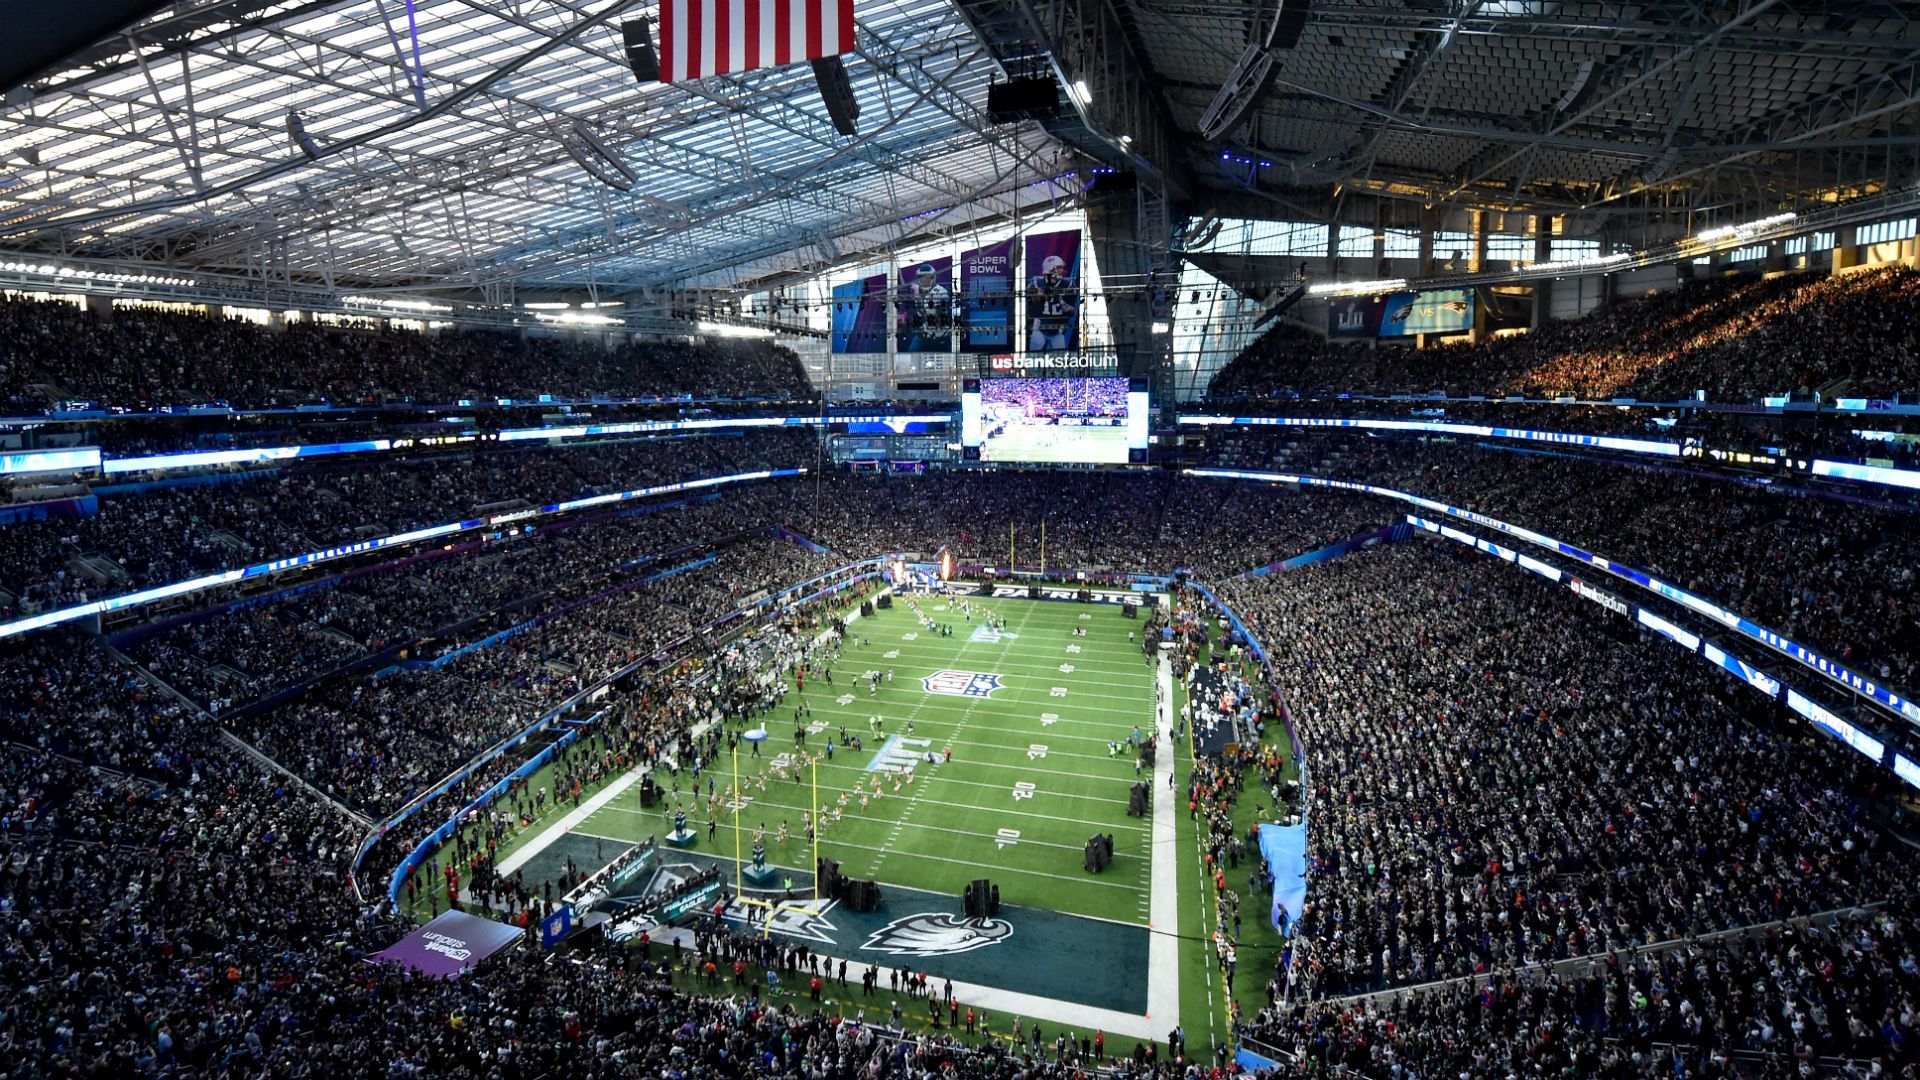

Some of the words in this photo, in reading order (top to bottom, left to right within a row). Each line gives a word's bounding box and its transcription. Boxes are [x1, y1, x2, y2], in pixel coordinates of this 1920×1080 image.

[970, 256, 1006, 265] SUPER
[970, 265, 1001, 274] BOWL
[1532, 431, 1584, 445] ENGLAND
[308, 541, 371, 562] ENGLAND
[1759, 628, 1789, 651] NEW
[1797, 647, 1876, 697] ENGLAND
[1027, 744, 1049, 759] 30
[1012, 782, 1036, 799] 20
[995, 828, 1021, 845] 10
[663, 882, 721, 914] PHILADELPHIA
[678, 894, 707, 913] EAGLES
[422, 931, 466, 949] stadium
